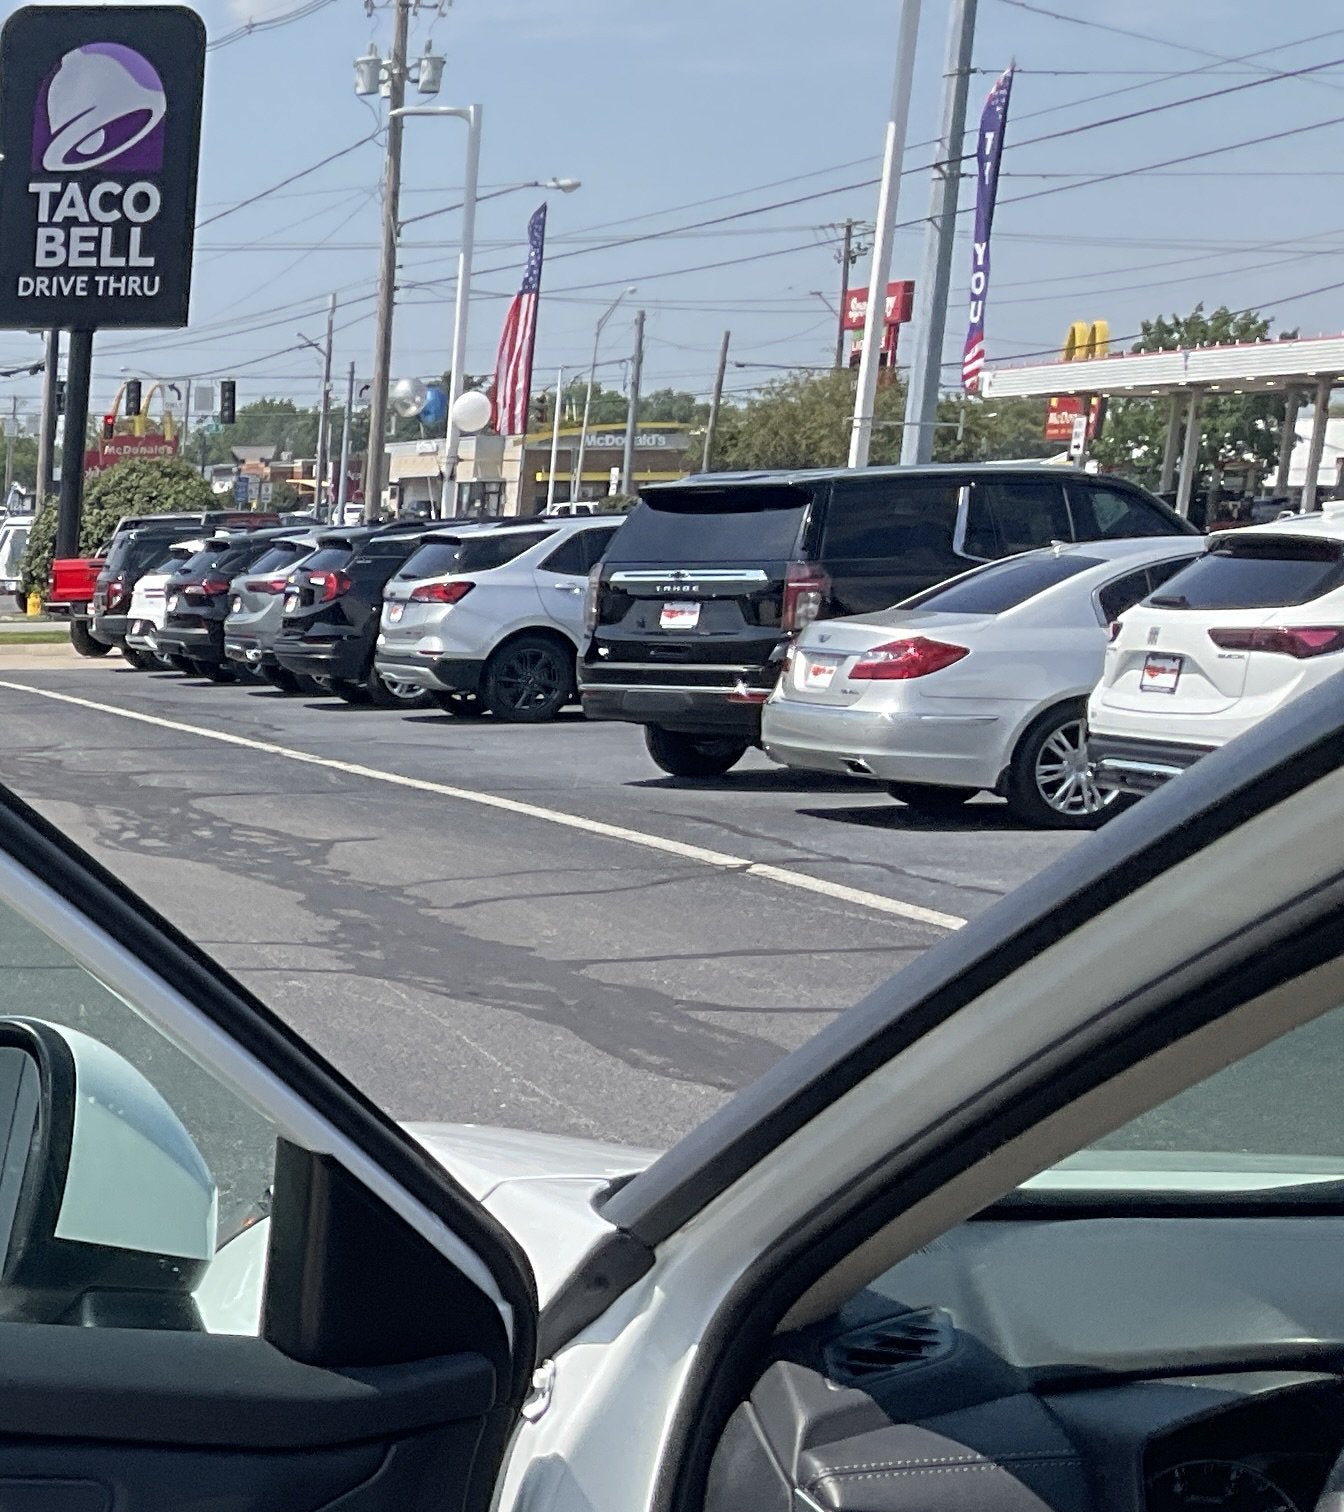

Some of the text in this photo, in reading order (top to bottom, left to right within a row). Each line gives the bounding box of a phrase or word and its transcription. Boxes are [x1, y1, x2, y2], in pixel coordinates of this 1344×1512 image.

[28, 181, 161, 223] TACO
[34, 226, 155, 268] BELL
[17, 275, 161, 297] DRIVE THRU
[969, 242, 987, 324] YOU
[104, 444, 174, 456] McDonald's
